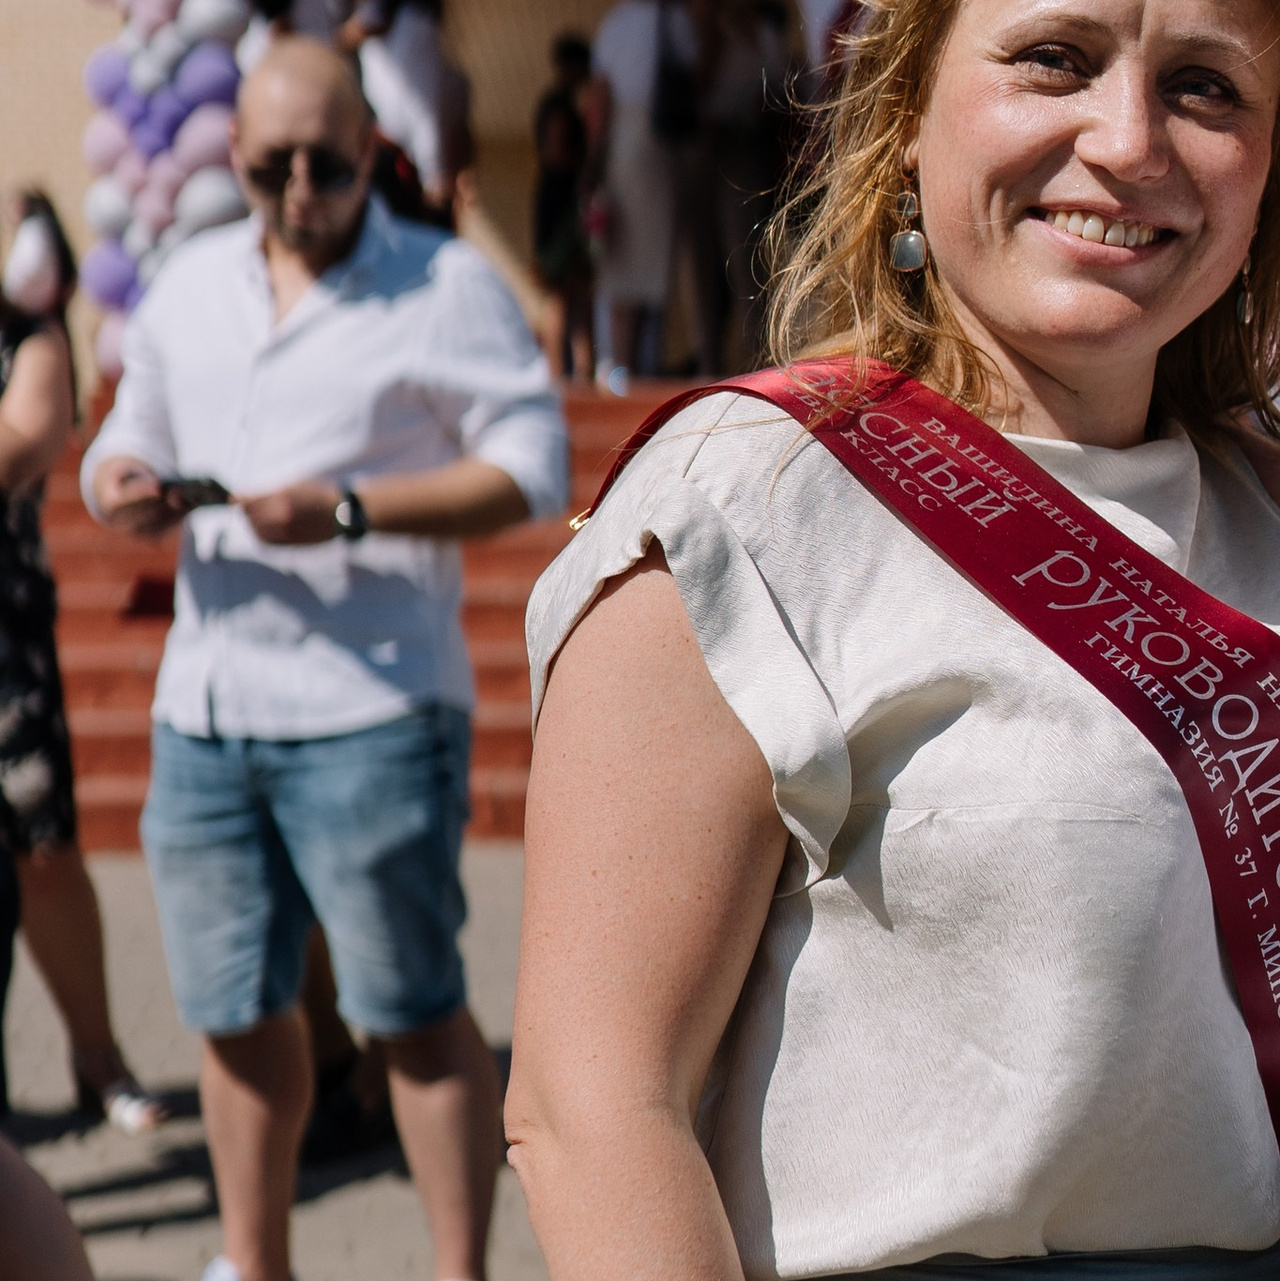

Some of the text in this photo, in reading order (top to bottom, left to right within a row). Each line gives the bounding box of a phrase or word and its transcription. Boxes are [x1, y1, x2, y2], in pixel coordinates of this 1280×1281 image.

[839, 431, 943, 512] КЛАСС
[1083, 631, 1225, 793] ГИМНАЗИЯ
[1217, 797, 1239, 840] №
[1234, 846, 1258, 877] 37
[920, 416, 1100, 553] ВАШИЛИНА
[1109, 556, 1256, 669] НАТАЛЬЯ
